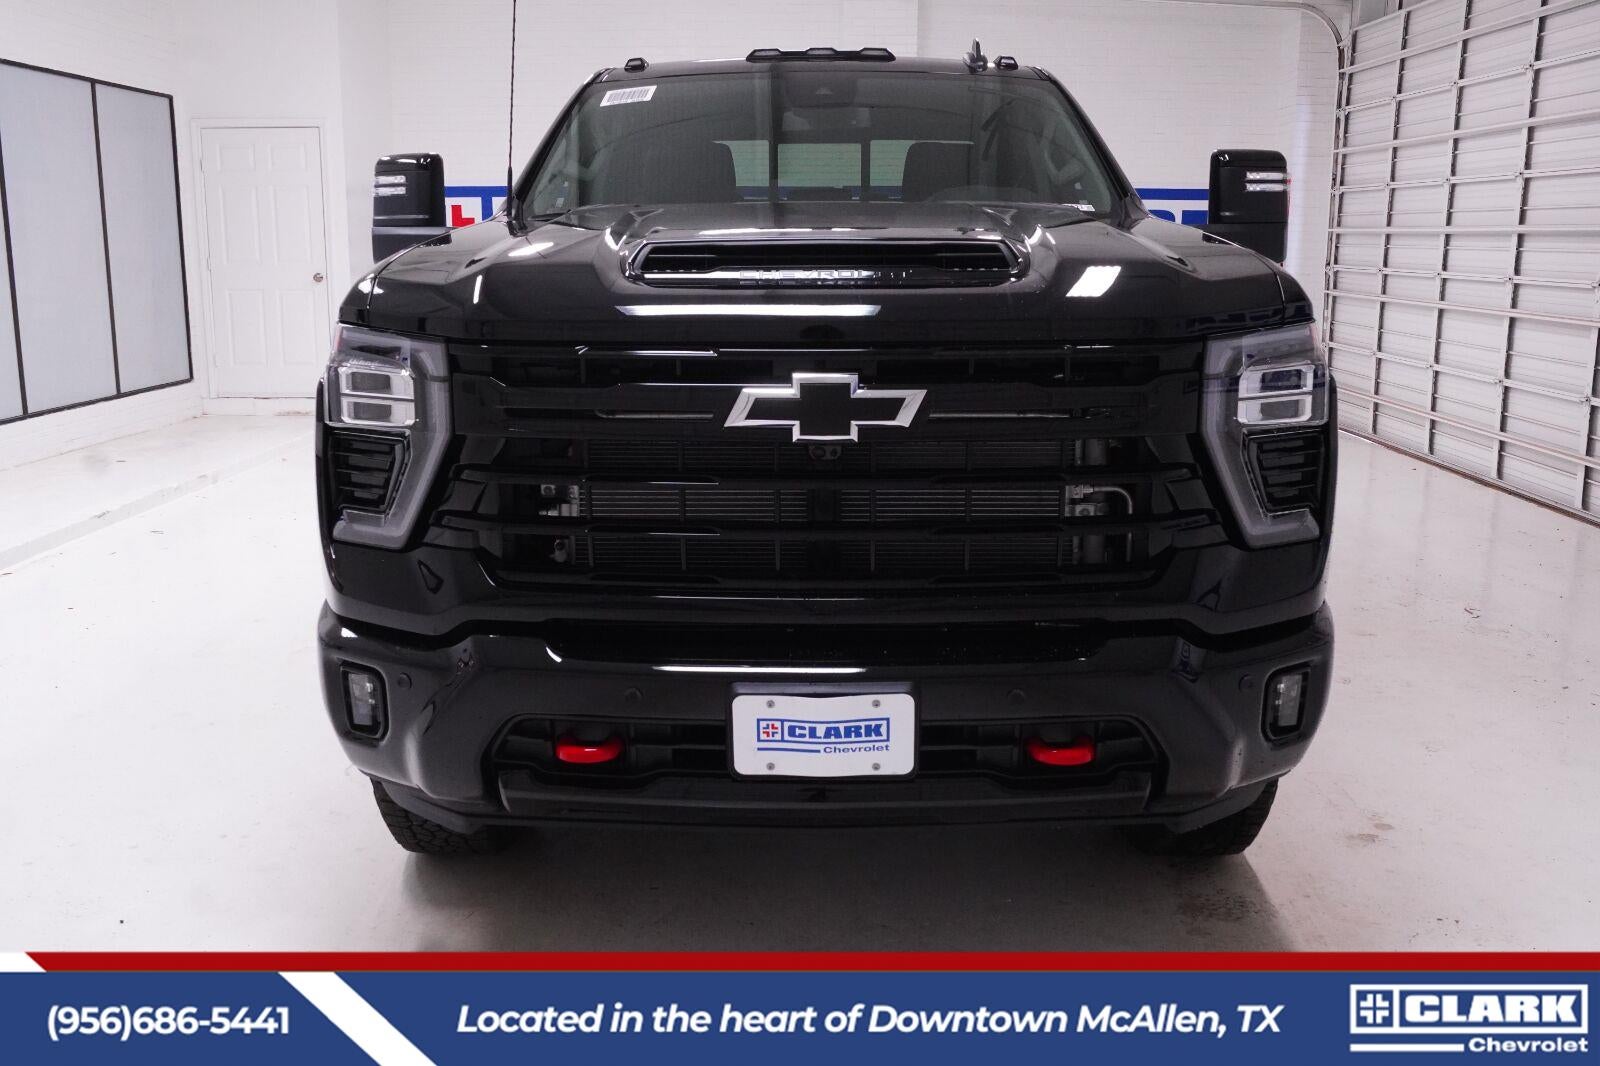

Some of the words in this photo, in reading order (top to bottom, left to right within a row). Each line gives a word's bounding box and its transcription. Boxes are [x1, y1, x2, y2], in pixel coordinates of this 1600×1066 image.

[738, 269, 912, 281] CHEVROL
[787, 723, 883, 740] CLARK
[823, 744, 890, 754] Chevrolet
